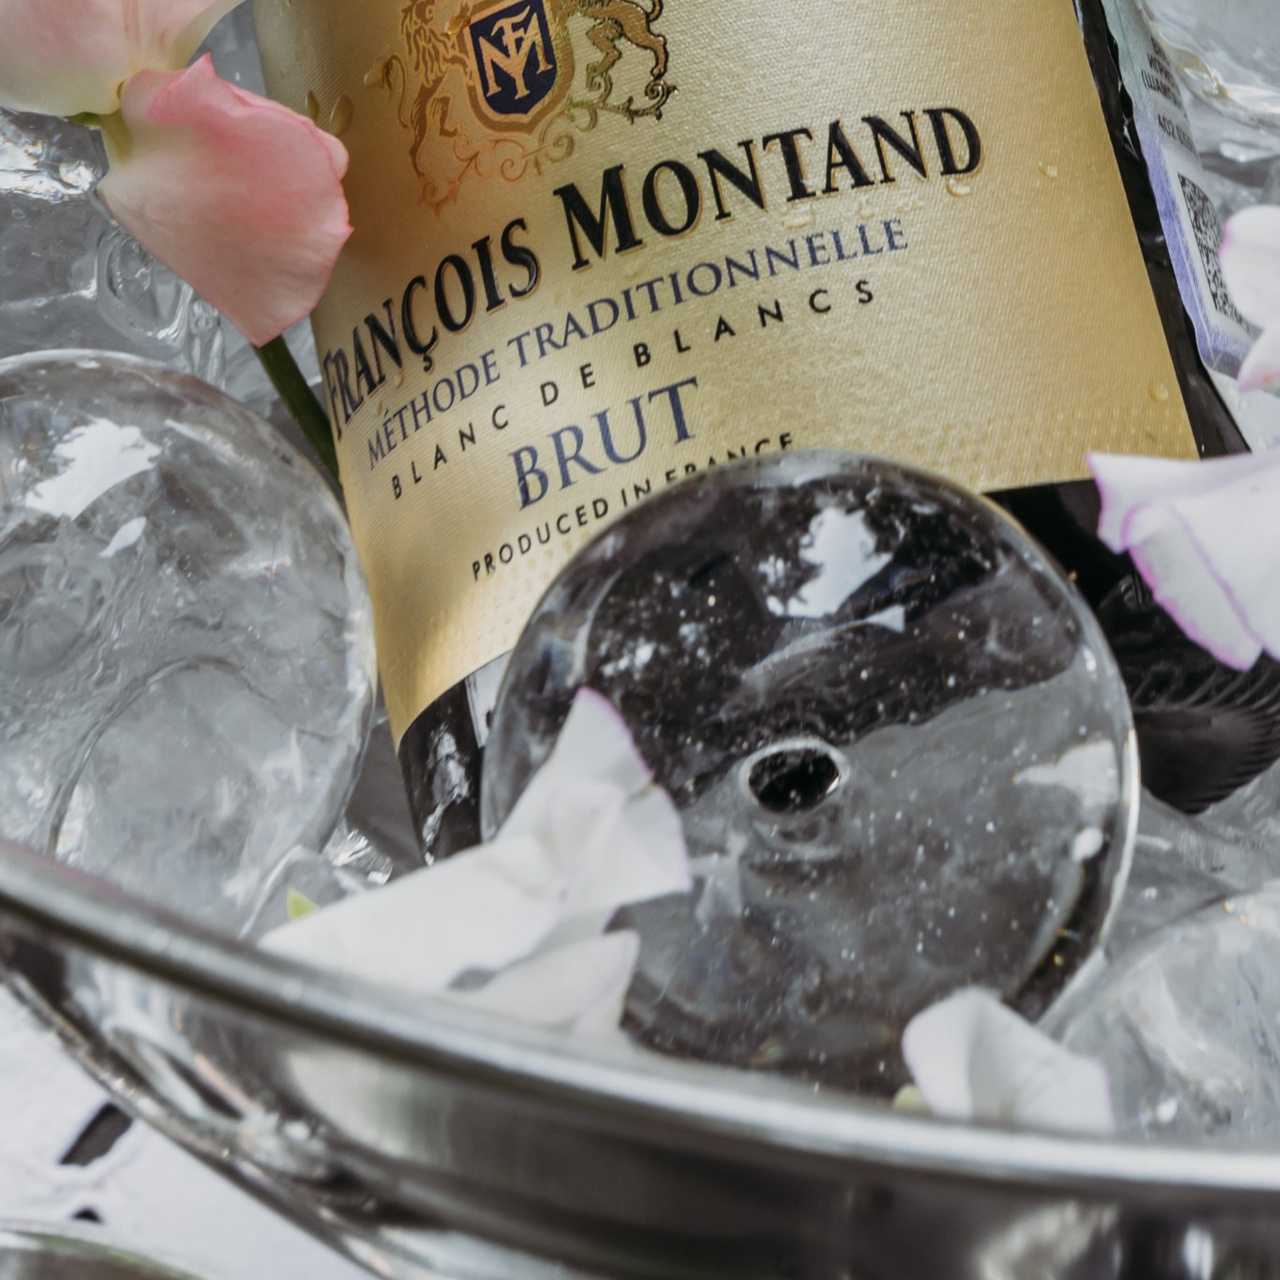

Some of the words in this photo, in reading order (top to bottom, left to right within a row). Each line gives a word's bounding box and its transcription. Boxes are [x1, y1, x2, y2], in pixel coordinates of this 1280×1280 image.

[323, 217, 541, 439] FRANÇOIS
[552, 106, 984, 271] MONTAND
[367, 349, 500, 471] MÉTHODE
[507, 217, 909, 368] TRADITIONNELLE
[391, 404, 509, 500] BLANC
[539, 363, 596, 407] DE
[632, 278, 875, 368] BLANCS
[507, 376, 699, 511] BRUT
[472, 497, 608, 581] PRODUCED
